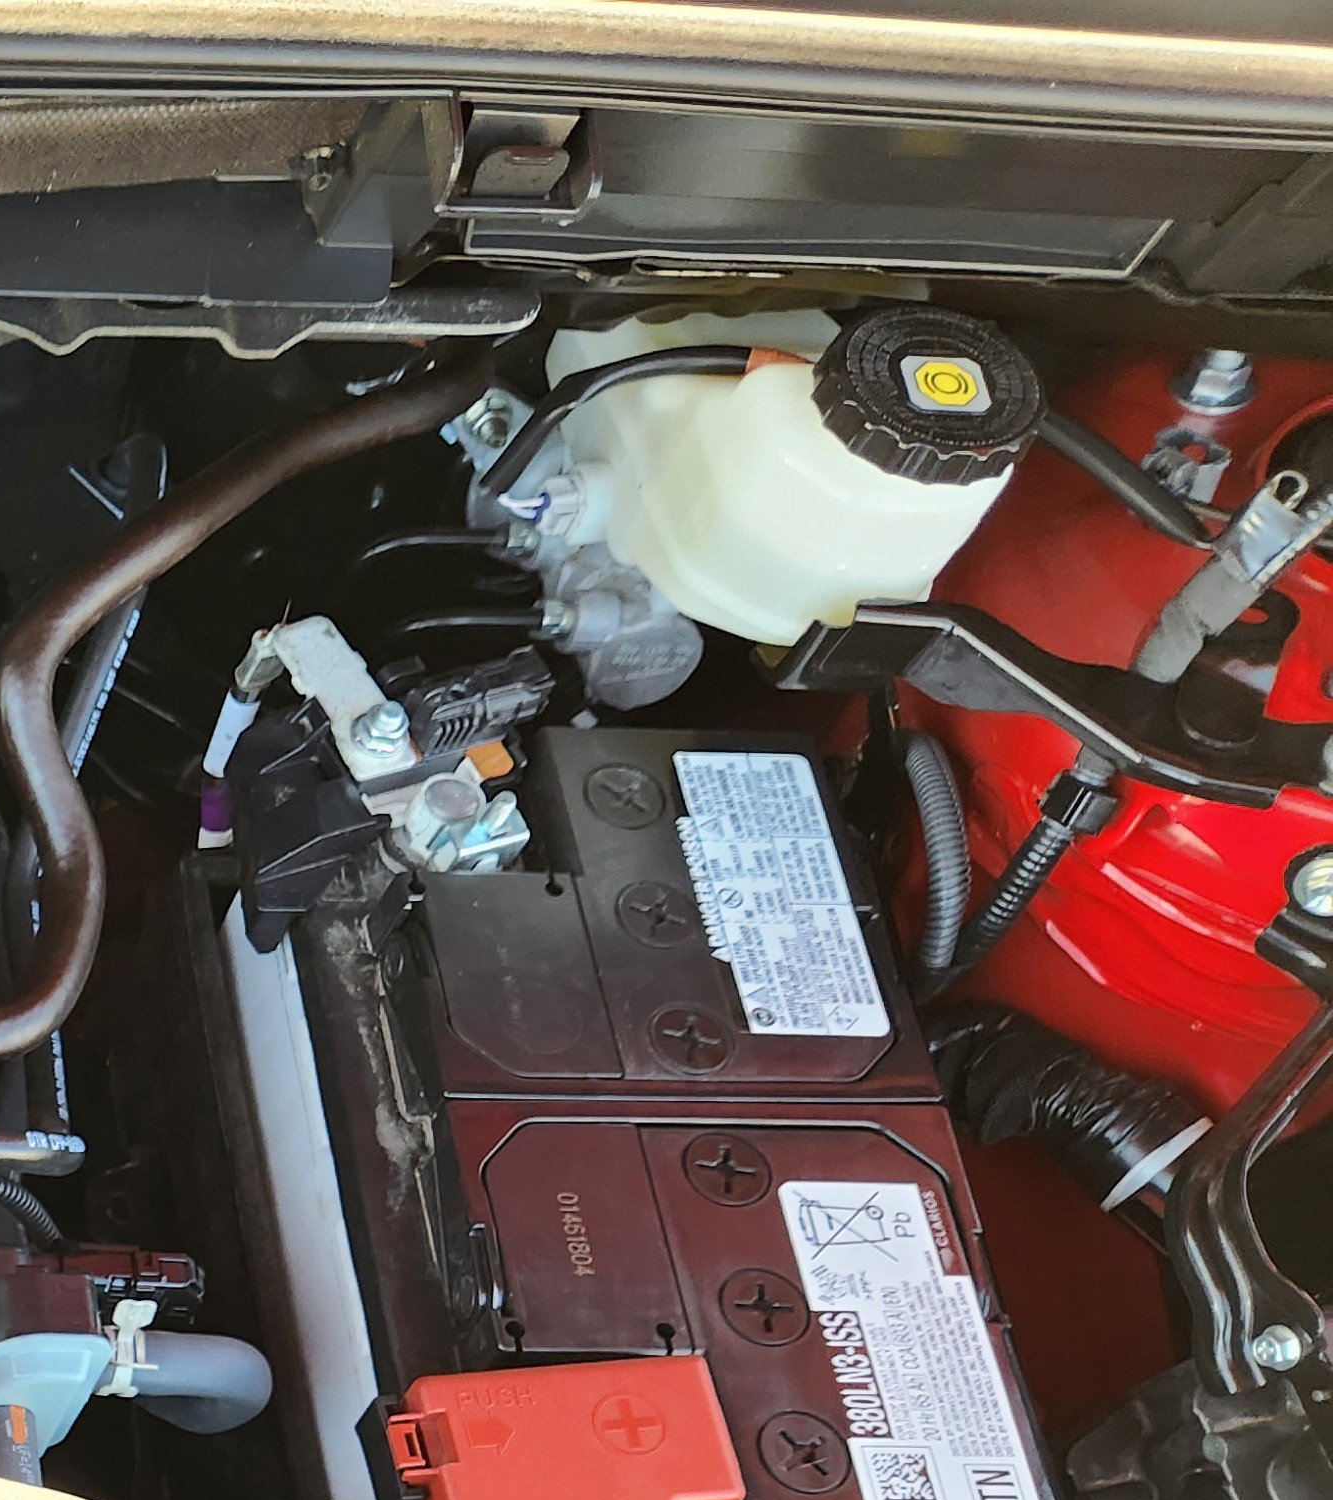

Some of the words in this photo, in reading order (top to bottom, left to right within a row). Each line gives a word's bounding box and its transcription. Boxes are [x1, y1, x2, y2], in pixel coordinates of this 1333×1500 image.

[889, 1210, 917, 1238] Pb
[922, 1190, 949, 1246] CLARIOS
[815, 1310, 890, 1435] 380LN3-ISS
[454, 1384, 536, 1411] PUSH
